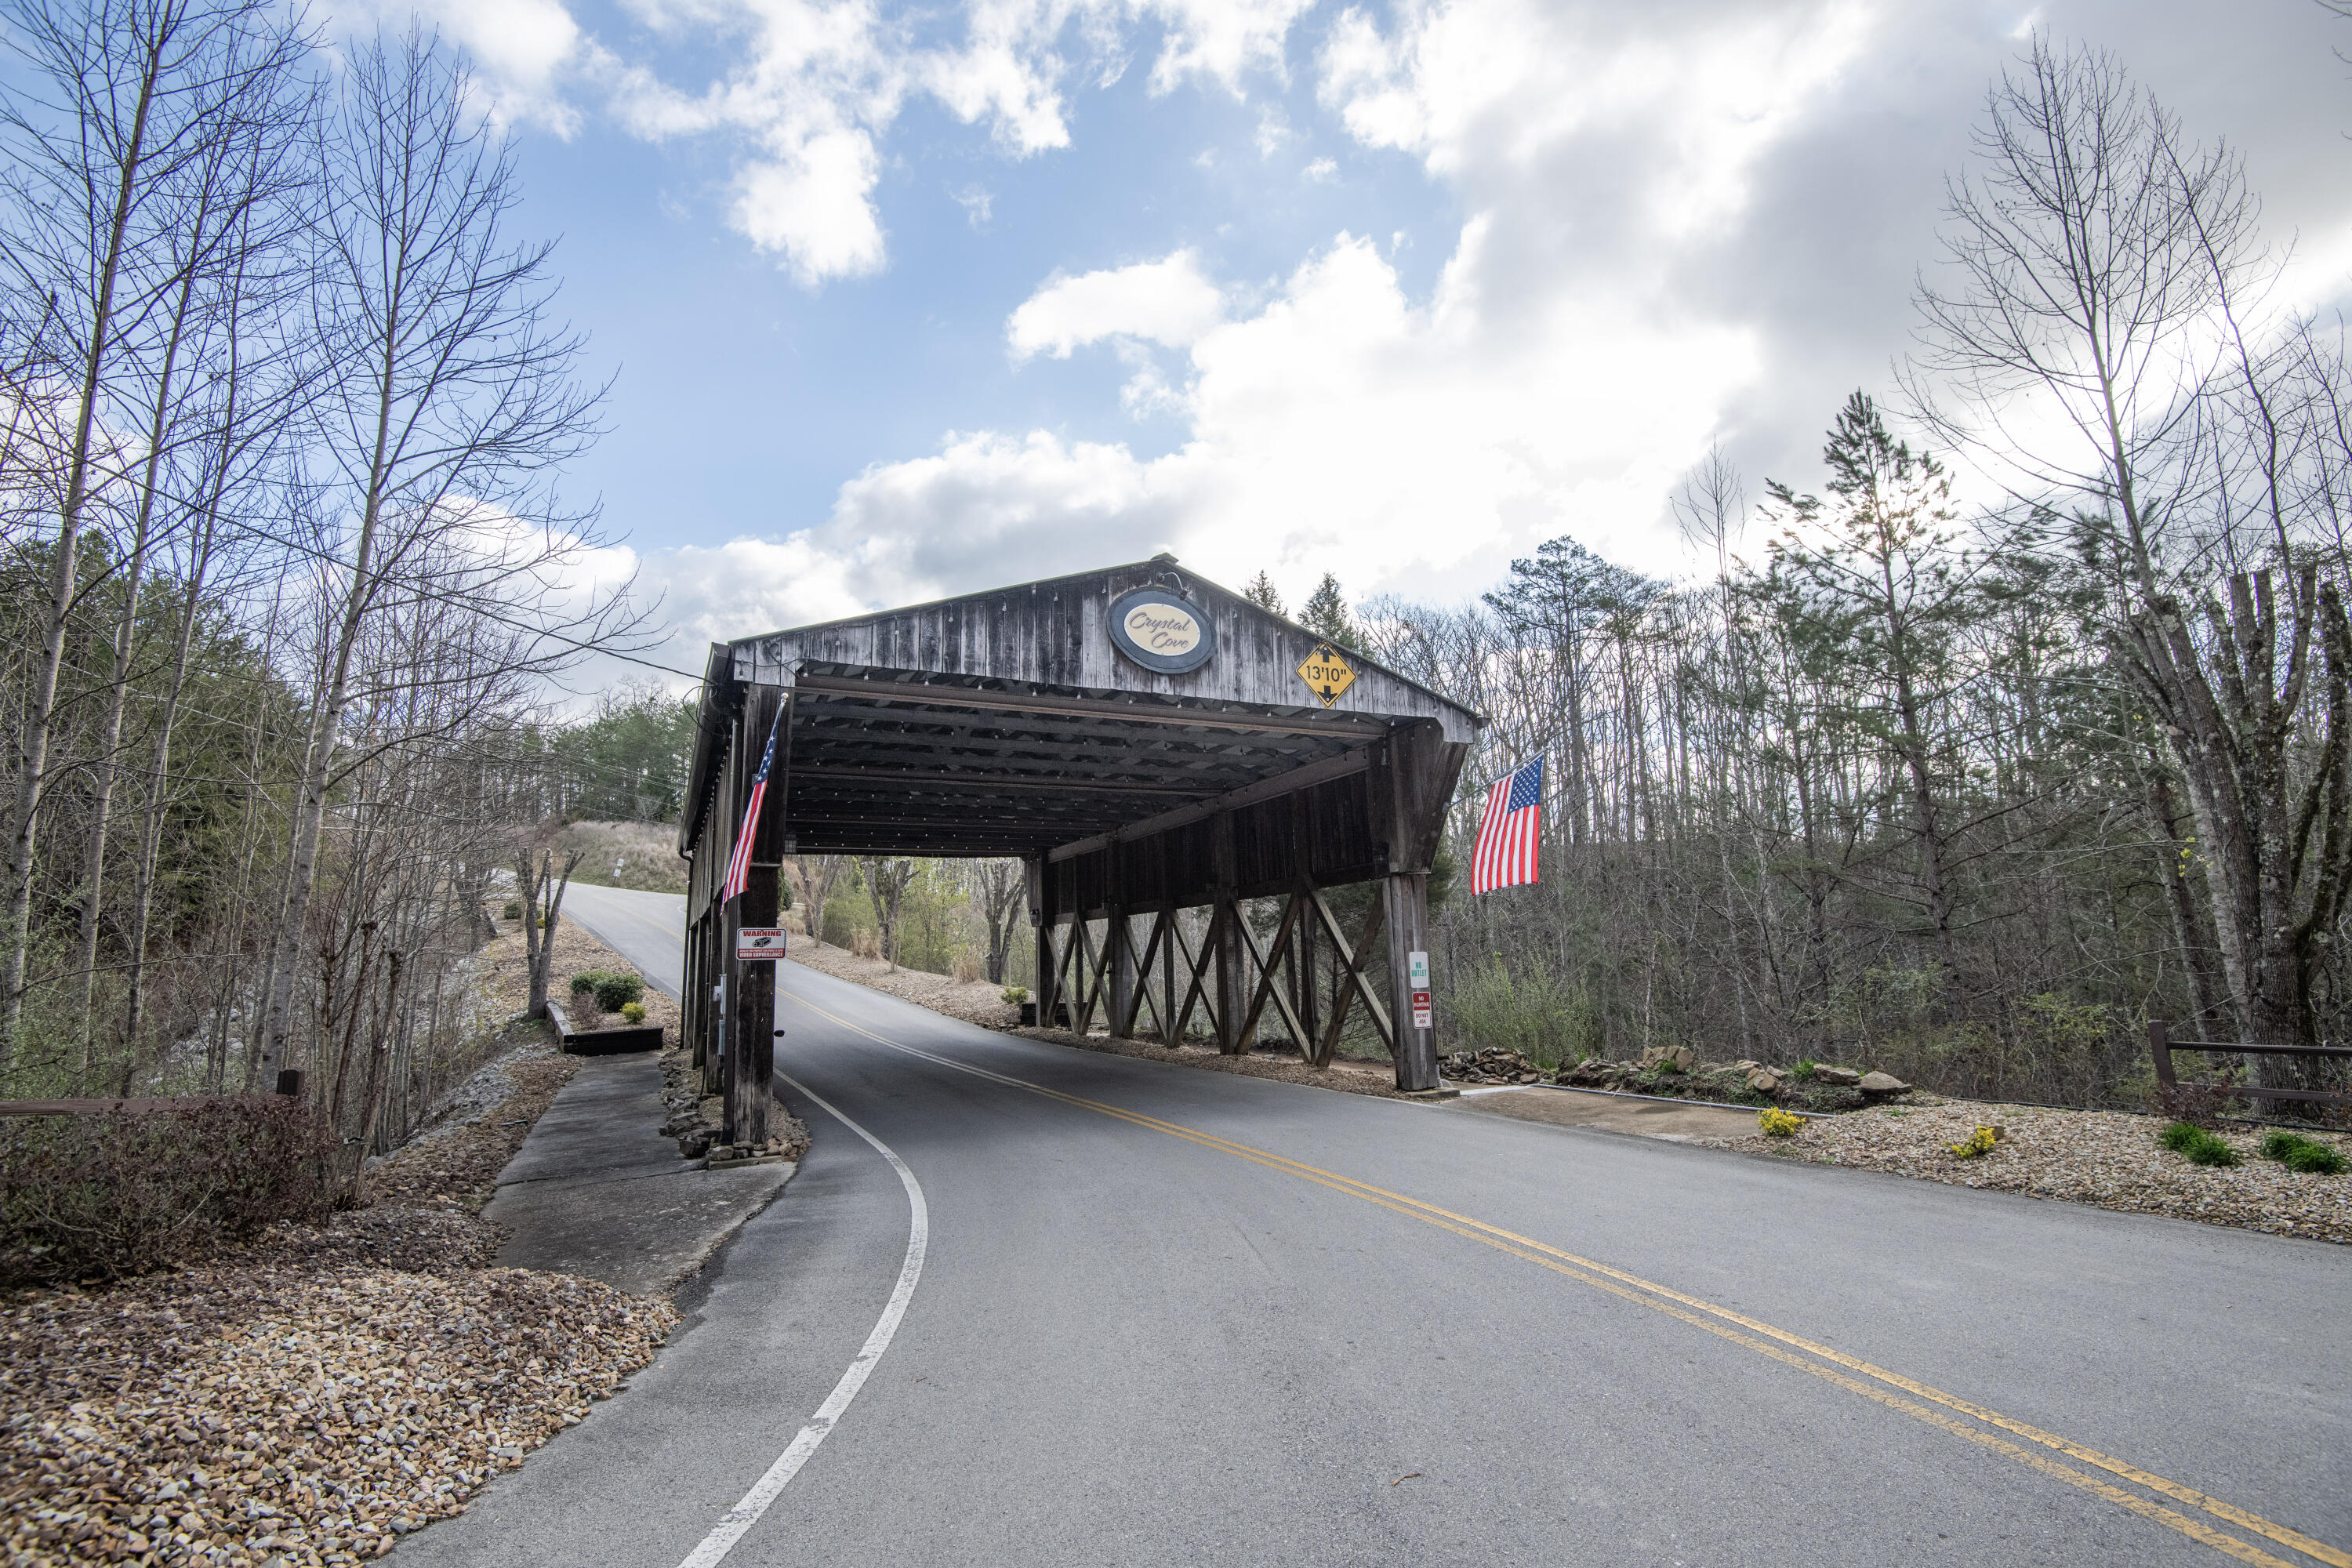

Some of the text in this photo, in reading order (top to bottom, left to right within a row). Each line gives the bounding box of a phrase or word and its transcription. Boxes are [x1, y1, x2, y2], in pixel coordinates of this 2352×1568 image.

[1130, 612, 1191, 633] Crystal
[1151, 632, 1189, 648] Cove
[1306, 665, 1347, 682] 13'10"
